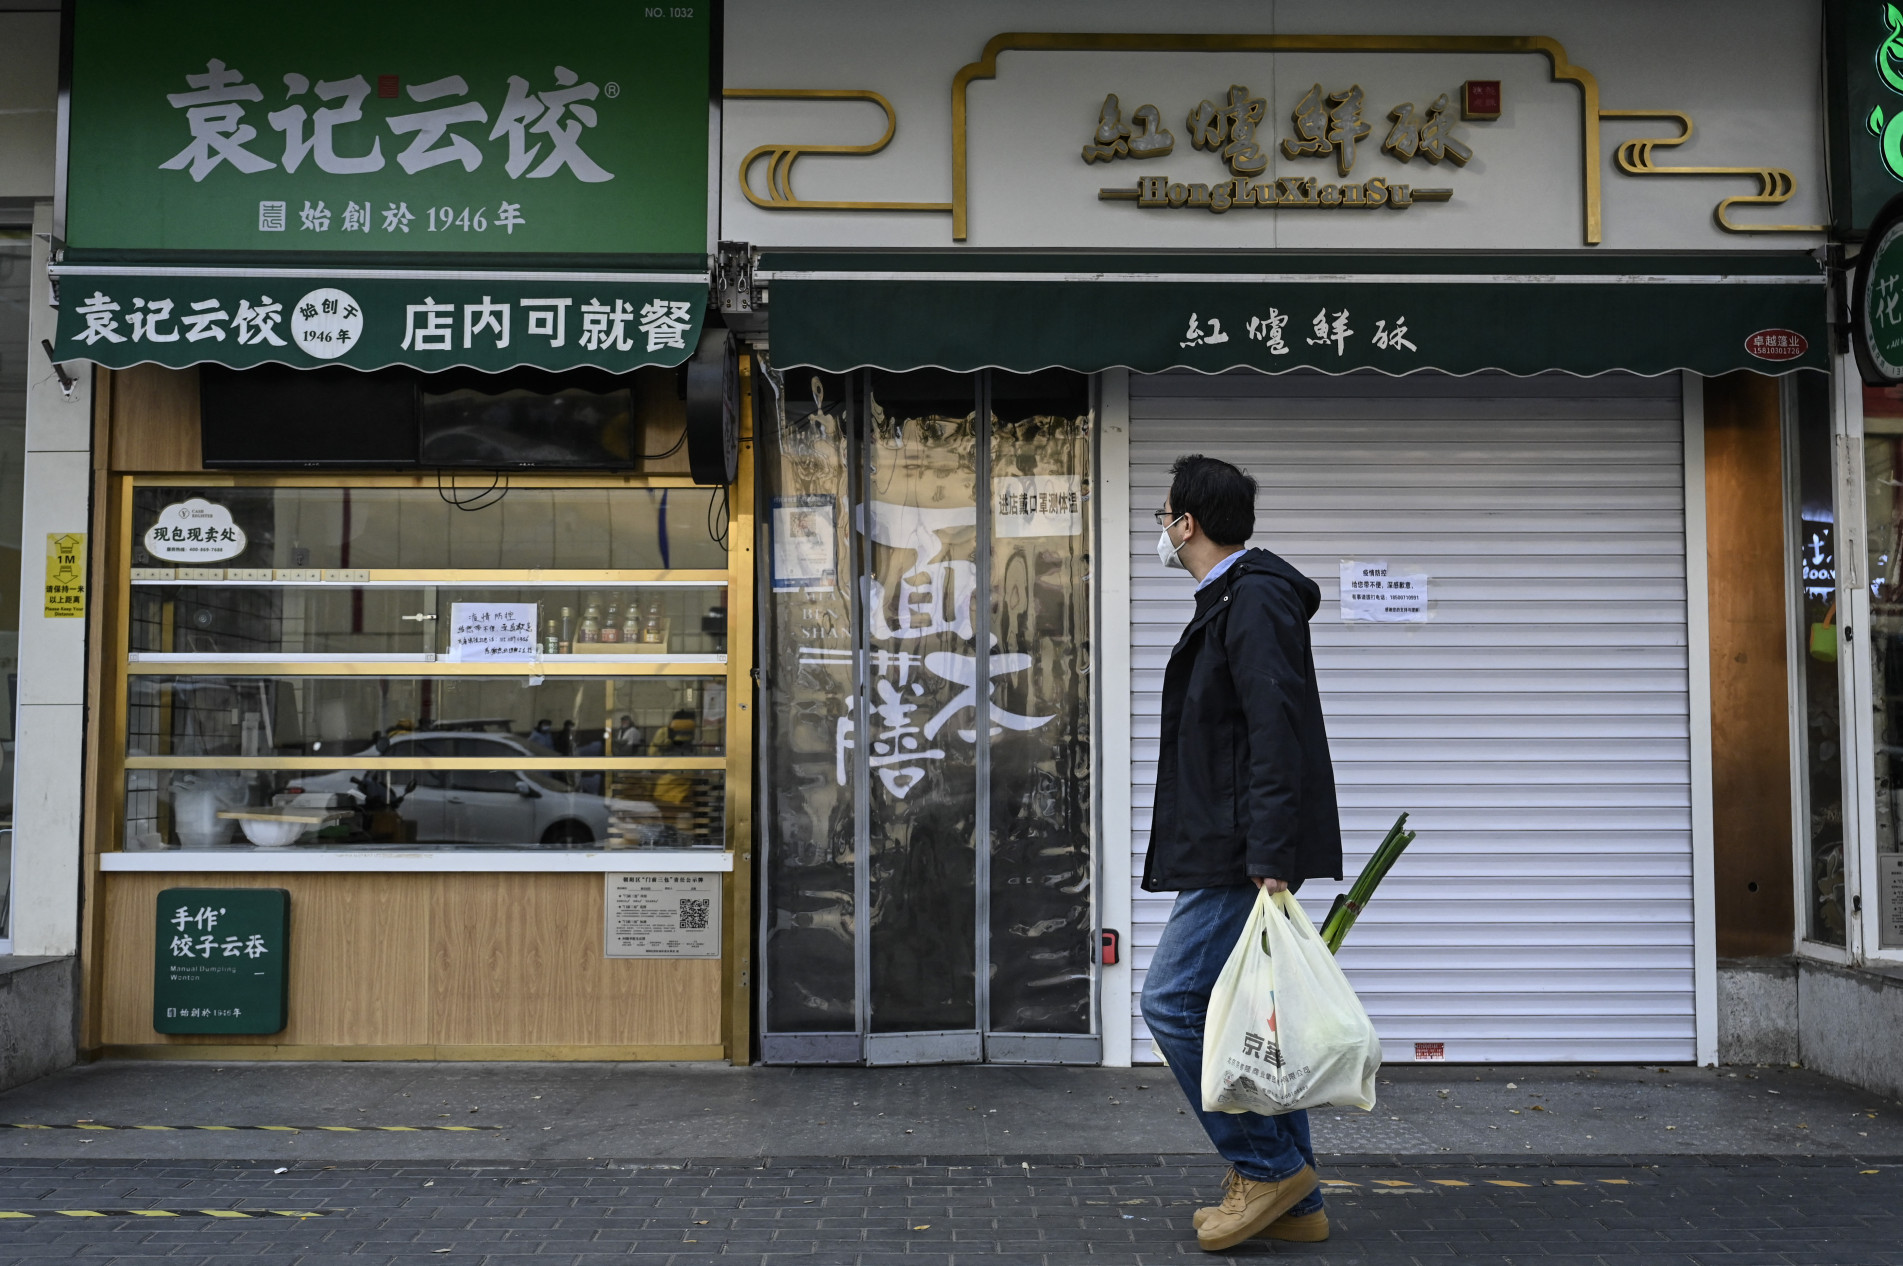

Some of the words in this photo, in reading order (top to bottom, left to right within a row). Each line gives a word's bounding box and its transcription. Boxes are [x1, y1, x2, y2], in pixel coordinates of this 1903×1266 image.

[645, 7, 666, 18] NO.
[670, 7, 694, 18] 1032
[158, 57, 615, 183] 袁记云饺
[1138, 175, 1414, 212] HongLuXianSu
[71, 291, 288, 346] 袁记云饺
[299, 298, 358, 321] 始创于
[400, 296, 692, 352] 店内可就餐
[1754, 335, 1800, 347] 卓越篷业
[1754, 347, 1800, 355] 15810301726
[999, 492, 1078, 515] 进店戴口罩测体温
[153, 526, 237, 543] 现包现卖处
[1363, 569, 1387, 577] 疫情防控
[169, 934, 269, 959] 饺子云吞
[170, 965, 198, 973] Manual
[199, 965, 237, 974] Dumpling
